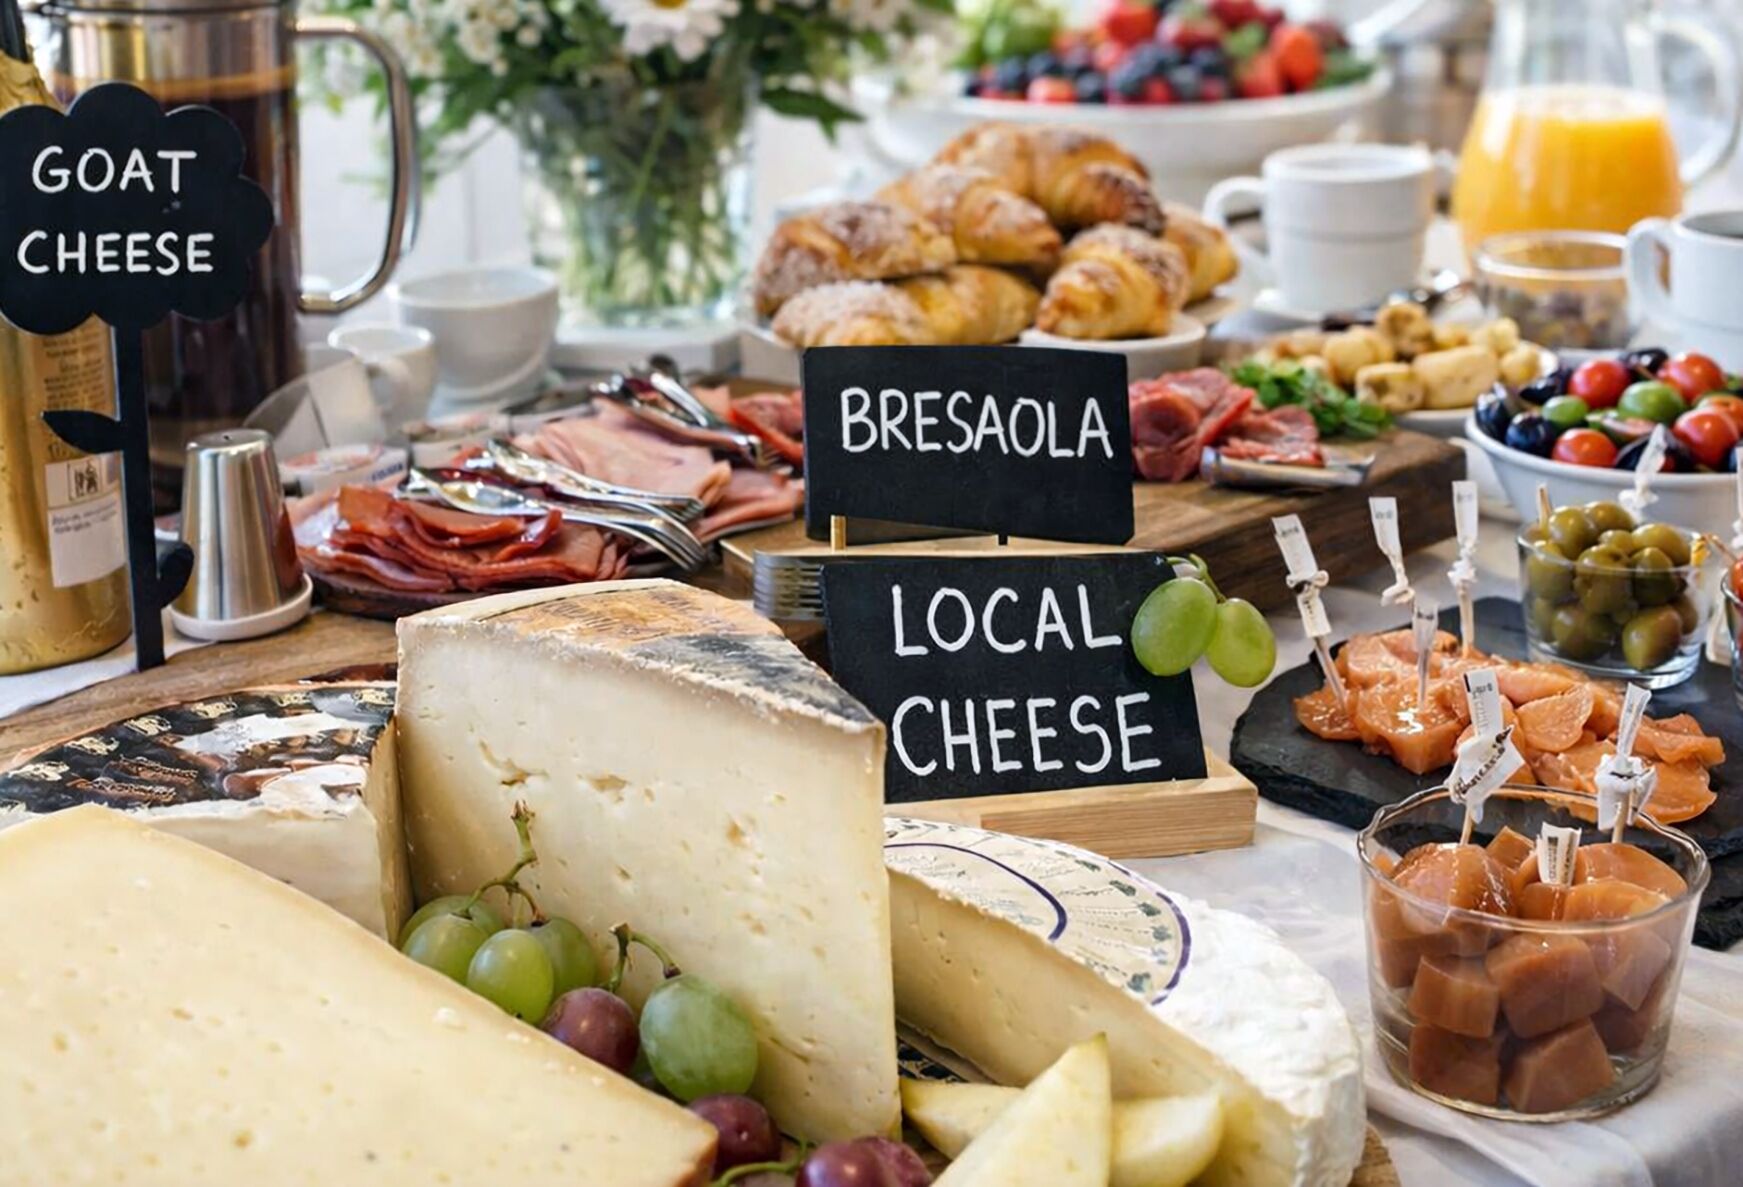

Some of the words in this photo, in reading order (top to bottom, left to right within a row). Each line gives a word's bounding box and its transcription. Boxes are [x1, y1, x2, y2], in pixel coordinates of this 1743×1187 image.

[33, 146, 197, 193] GOAT
[17, 230, 214, 276] CHEESE
[840, 387, 1113, 458] BRESAOLA
[891, 584, 1122, 656] LOCAL
[892, 692, 1162, 776] CHEESE
